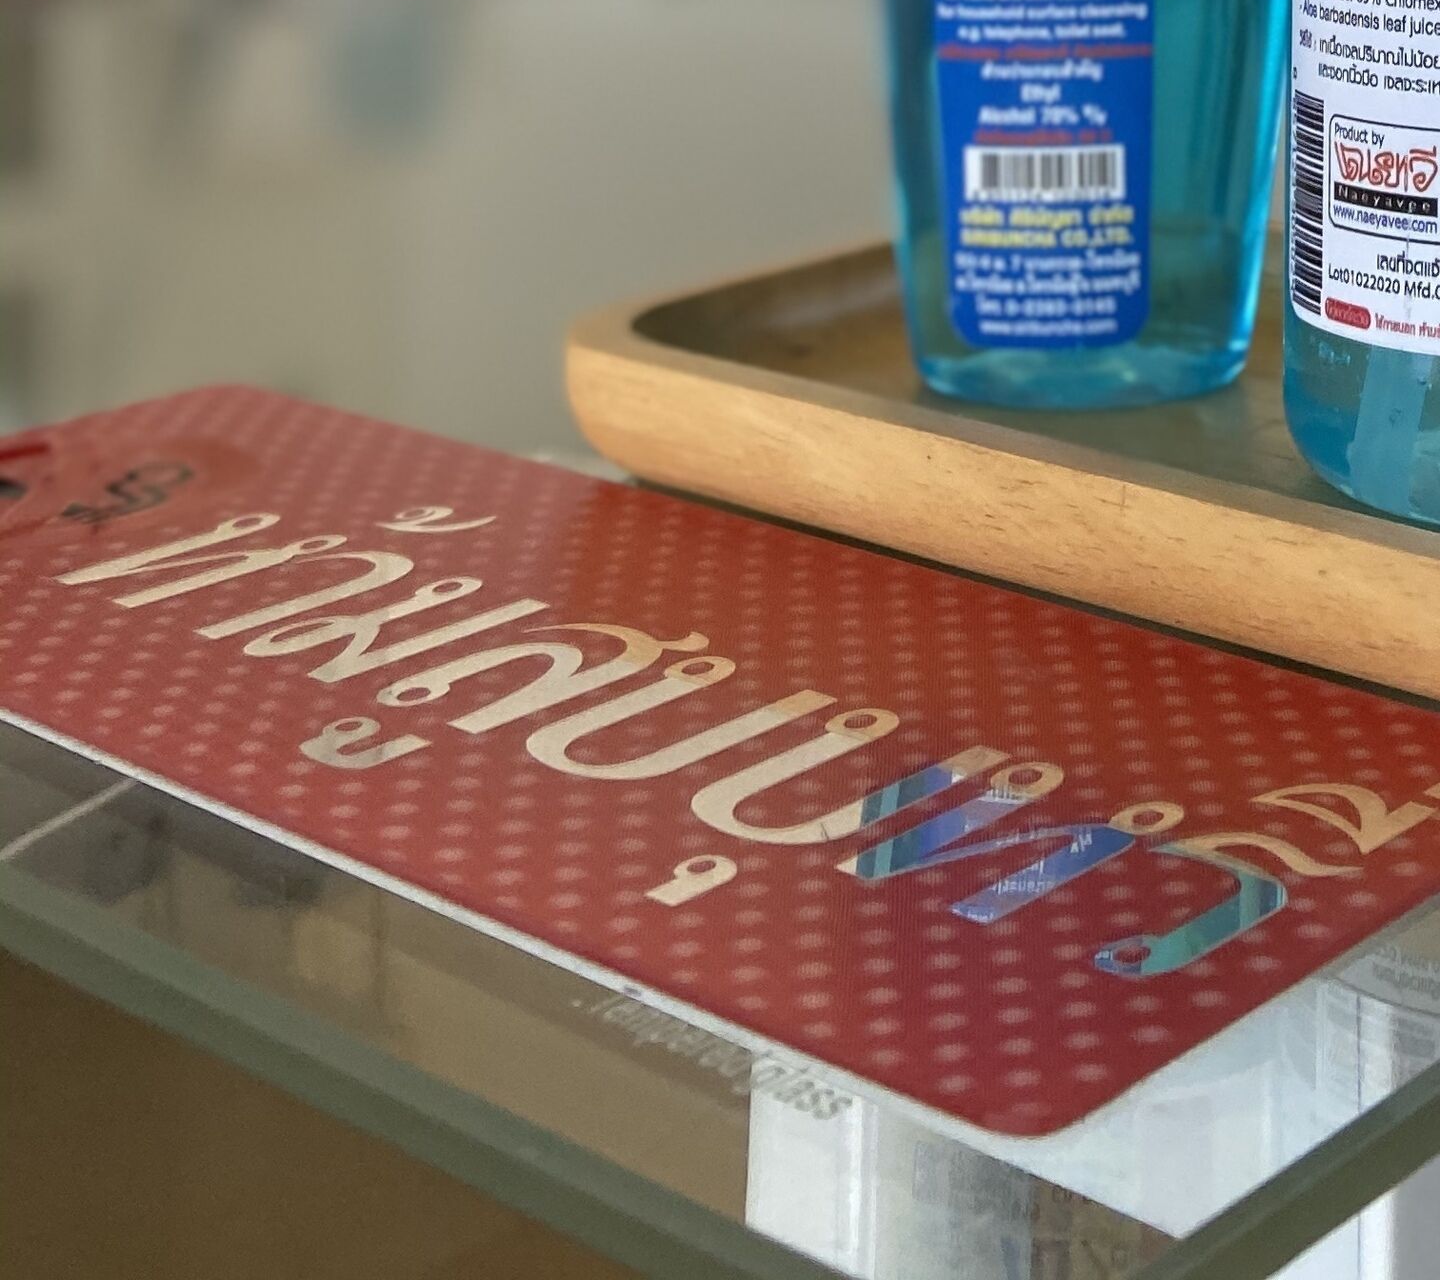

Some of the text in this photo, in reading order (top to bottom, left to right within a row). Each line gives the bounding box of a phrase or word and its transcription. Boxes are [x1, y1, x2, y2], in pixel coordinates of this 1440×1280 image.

[1319, 3, 1380, 30] barbadensis
[1383, 13, 1407, 33] leaf
[1334, 122, 1385, 150] Product by
[1333, 204, 1438, 235] www.naeyavee.com
[1327, 263, 1401, 295] Lot01022020
